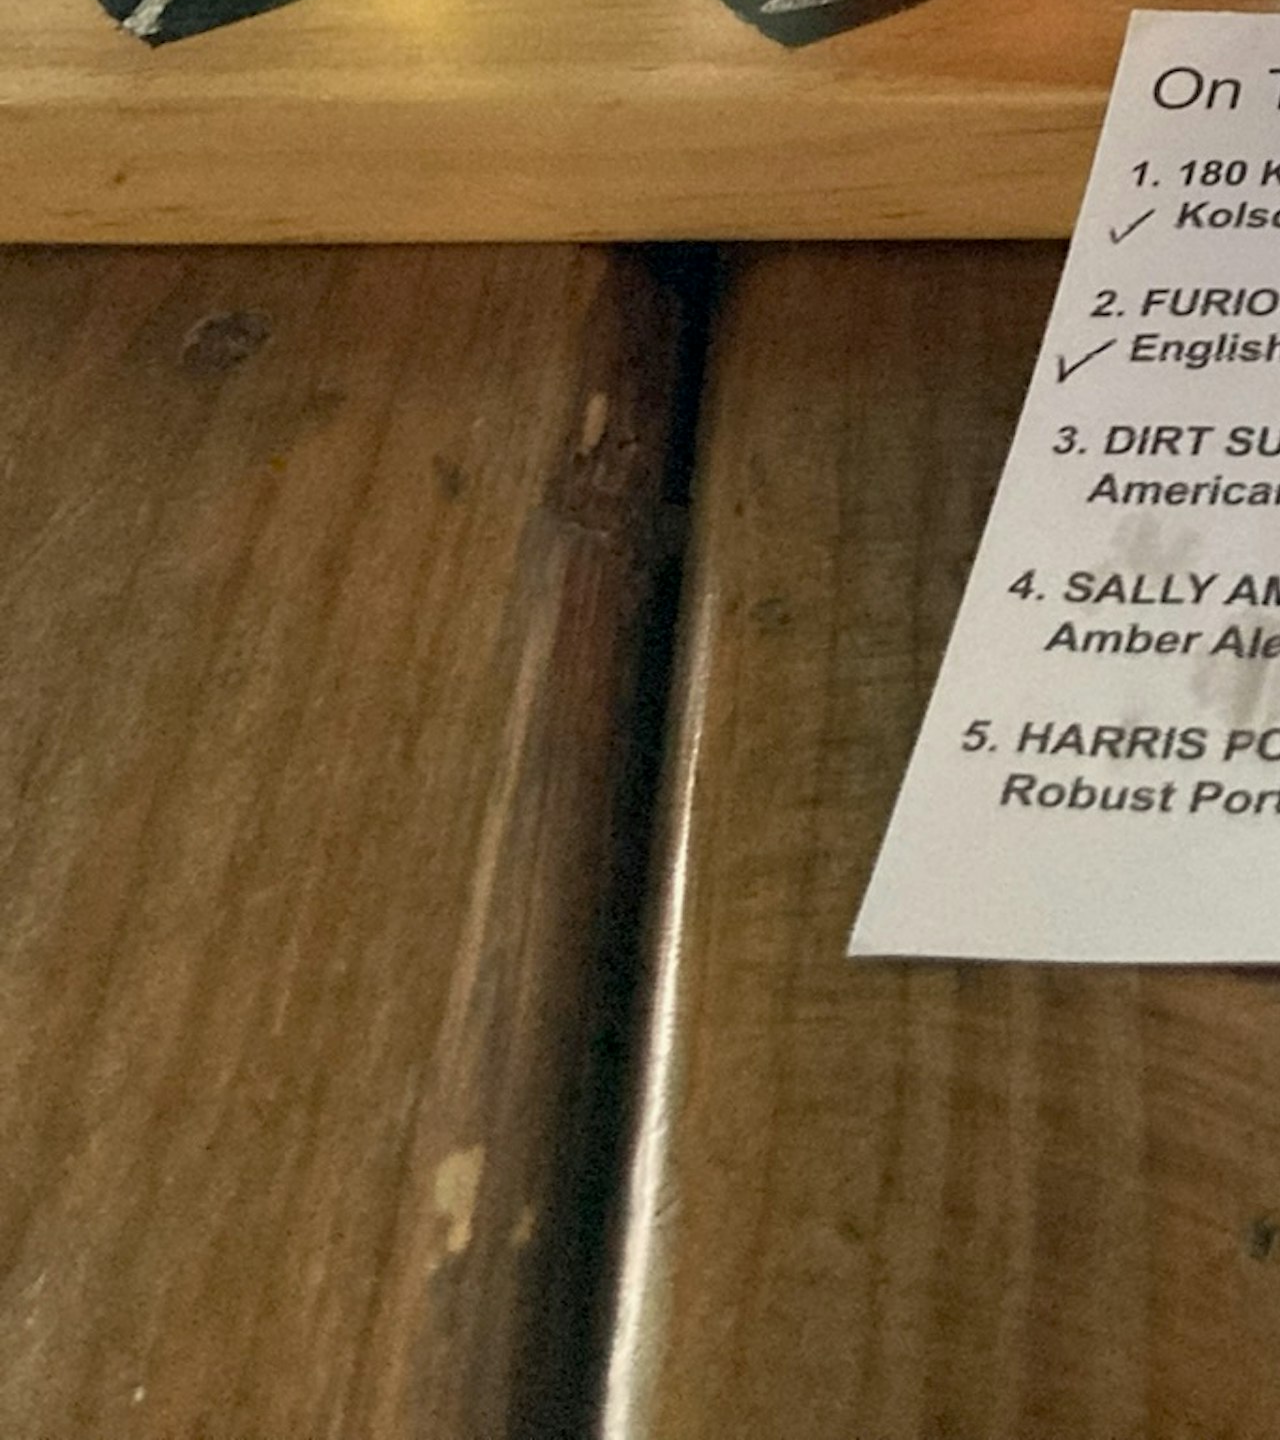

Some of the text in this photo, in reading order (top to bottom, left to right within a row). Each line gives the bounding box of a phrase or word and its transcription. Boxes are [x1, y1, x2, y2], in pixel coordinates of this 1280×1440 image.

[1153, 66, 1241, 110] On
[1133, 161, 1159, 187] 1.
[1180, 160, 1248, 186] 180
[1090, 290, 1124, 317] 2.
[1053, 426, 1086, 455] 3.
[1104, 426, 1215, 456] DIRT
[1008, 571, 1043, 600] 4.
[1064, 572, 1217, 604] SALLY
[1044, 622, 1202, 654] Amber
[961, 720, 1000, 752] 5.
[1017, 722, 1206, 760] HARRIS
[1001, 774, 1174, 812] Robust
